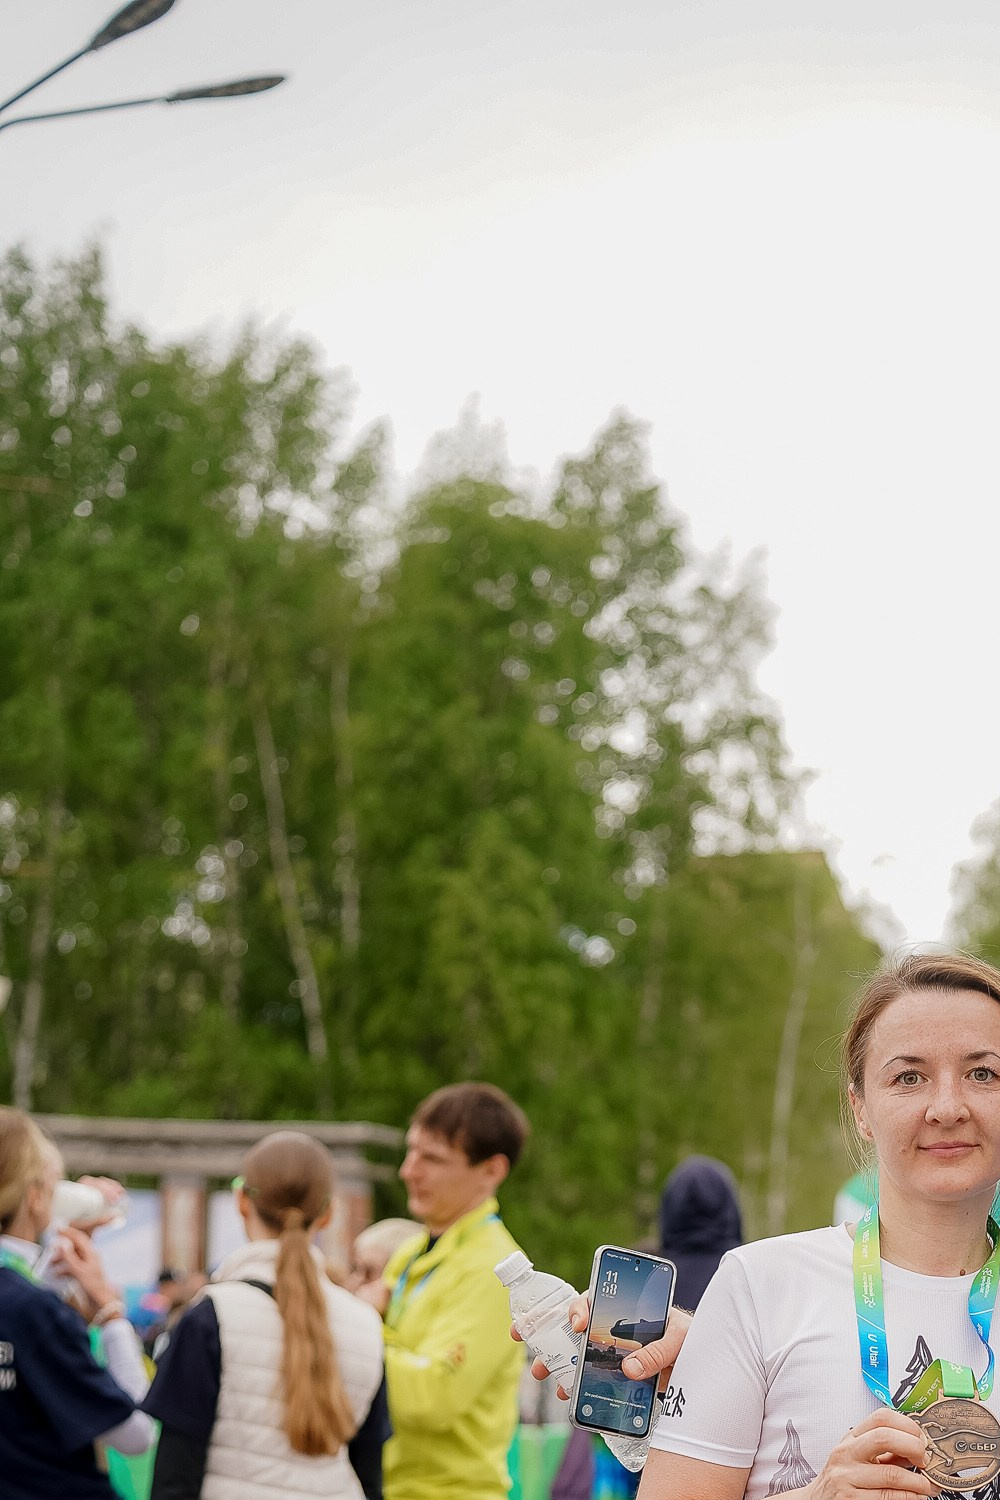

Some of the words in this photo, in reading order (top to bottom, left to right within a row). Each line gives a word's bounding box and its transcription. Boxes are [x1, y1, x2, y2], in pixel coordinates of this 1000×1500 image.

[605, 1270, 619, 1284] 11
[602, 1281, 618, 1296] 58
[869, 1345, 880, 1368] Utair
[912, 1395, 928, 1410] 185
[927, 1377, 941, 1396] лет
[969, 1442, 998, 1452] СБЕР
